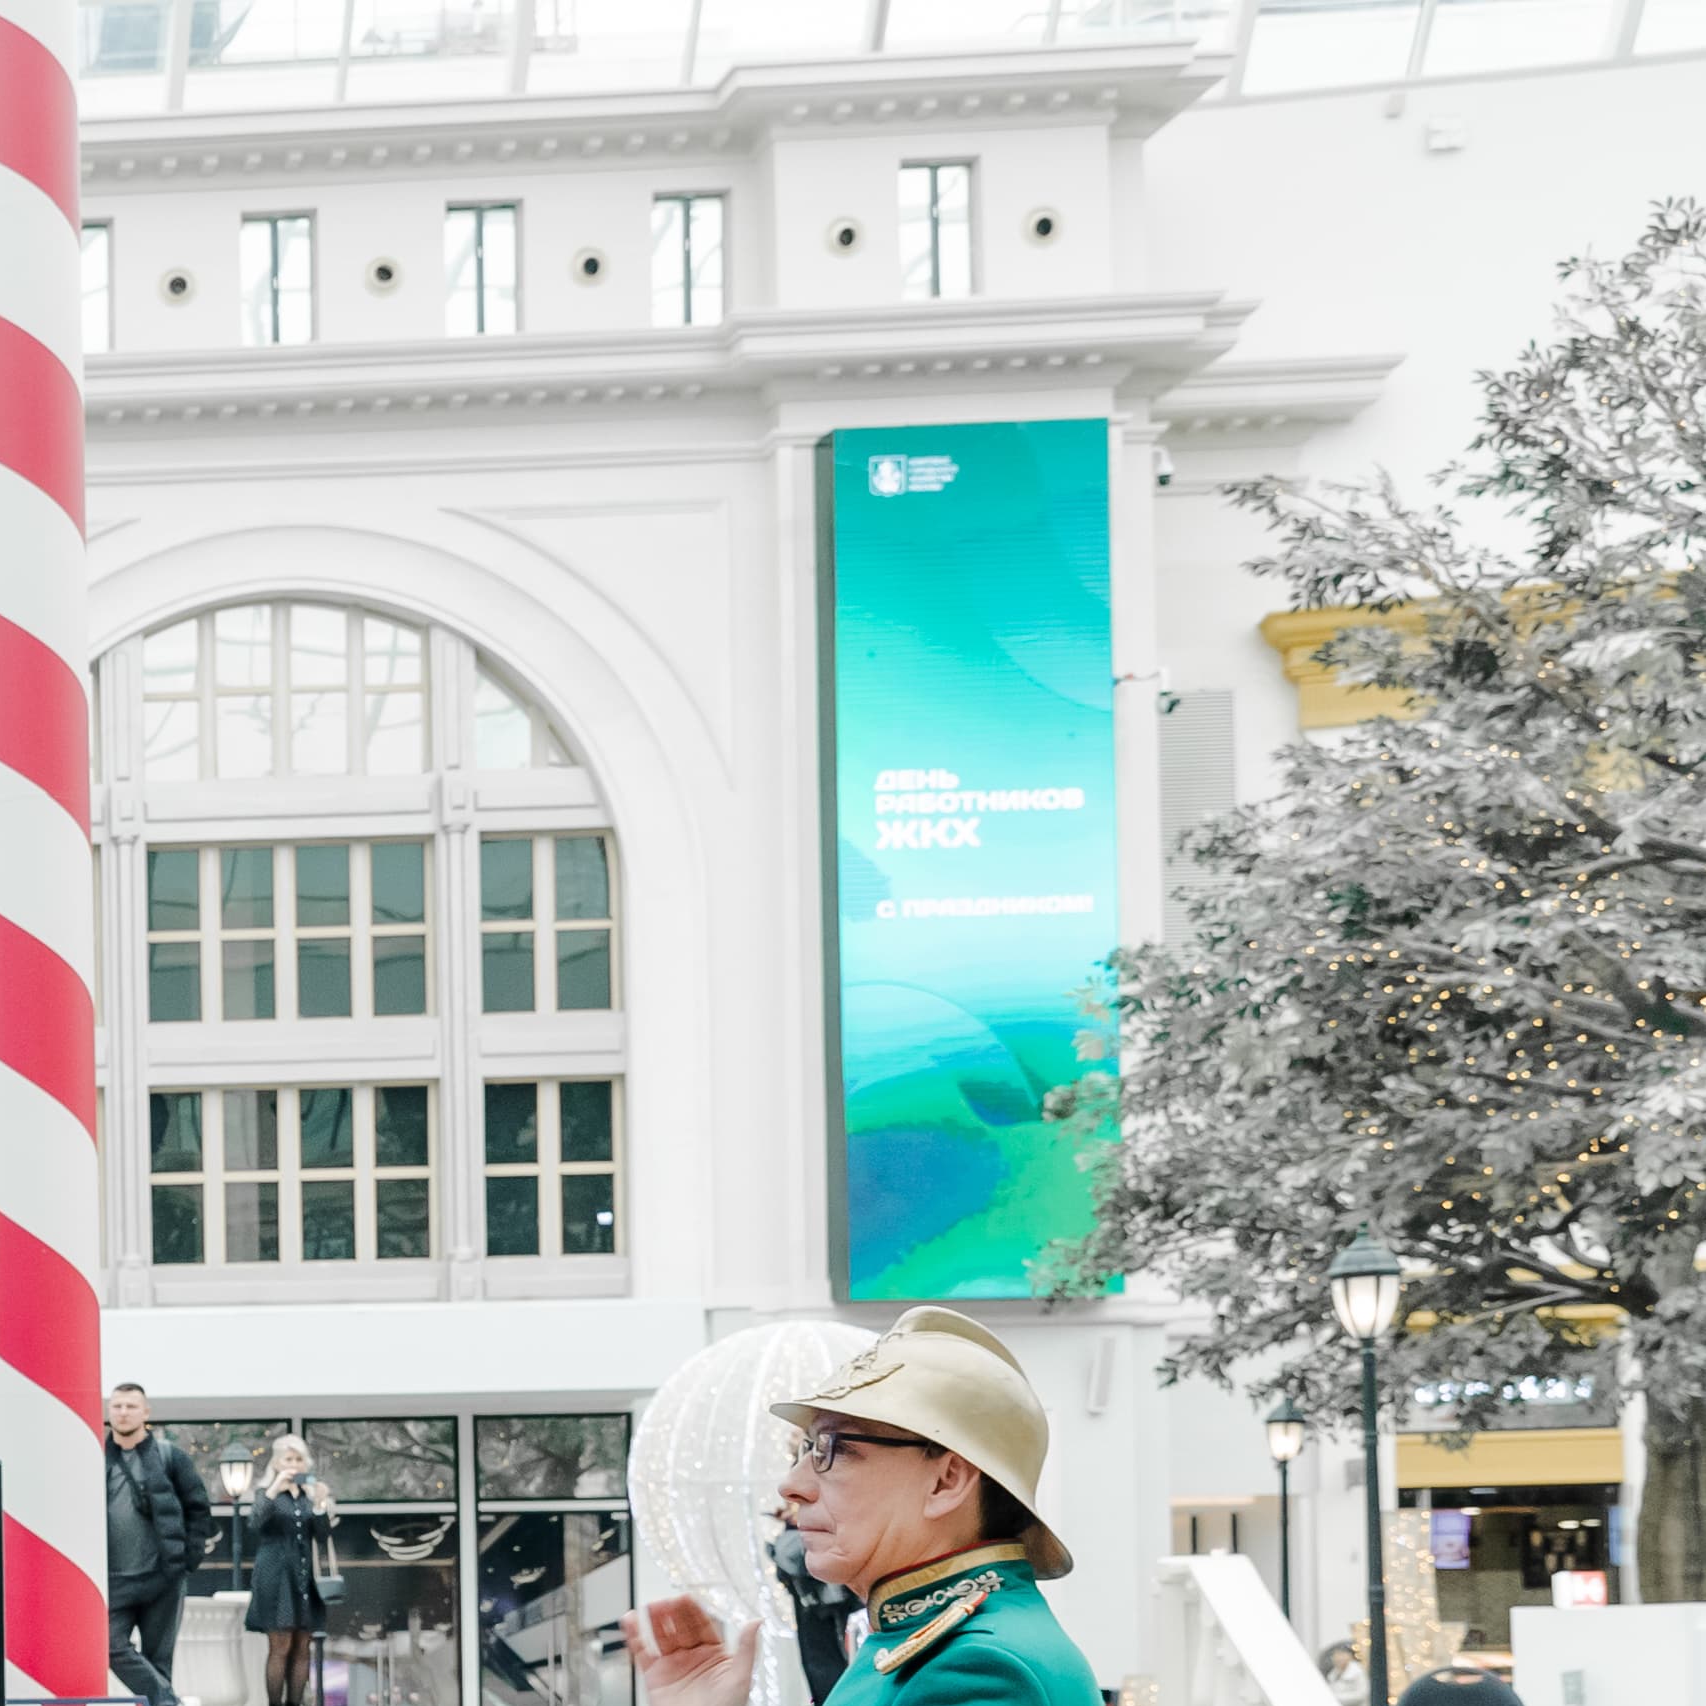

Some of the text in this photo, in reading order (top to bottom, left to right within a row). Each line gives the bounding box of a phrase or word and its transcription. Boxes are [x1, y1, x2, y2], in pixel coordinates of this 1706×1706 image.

[874, 769, 960, 791] ДЕНЬ
[875, 787, 1085, 815] РАБОТНИКОВ
[876, 816, 982, 849] ЖКХ
[876, 900, 896, 918] С
